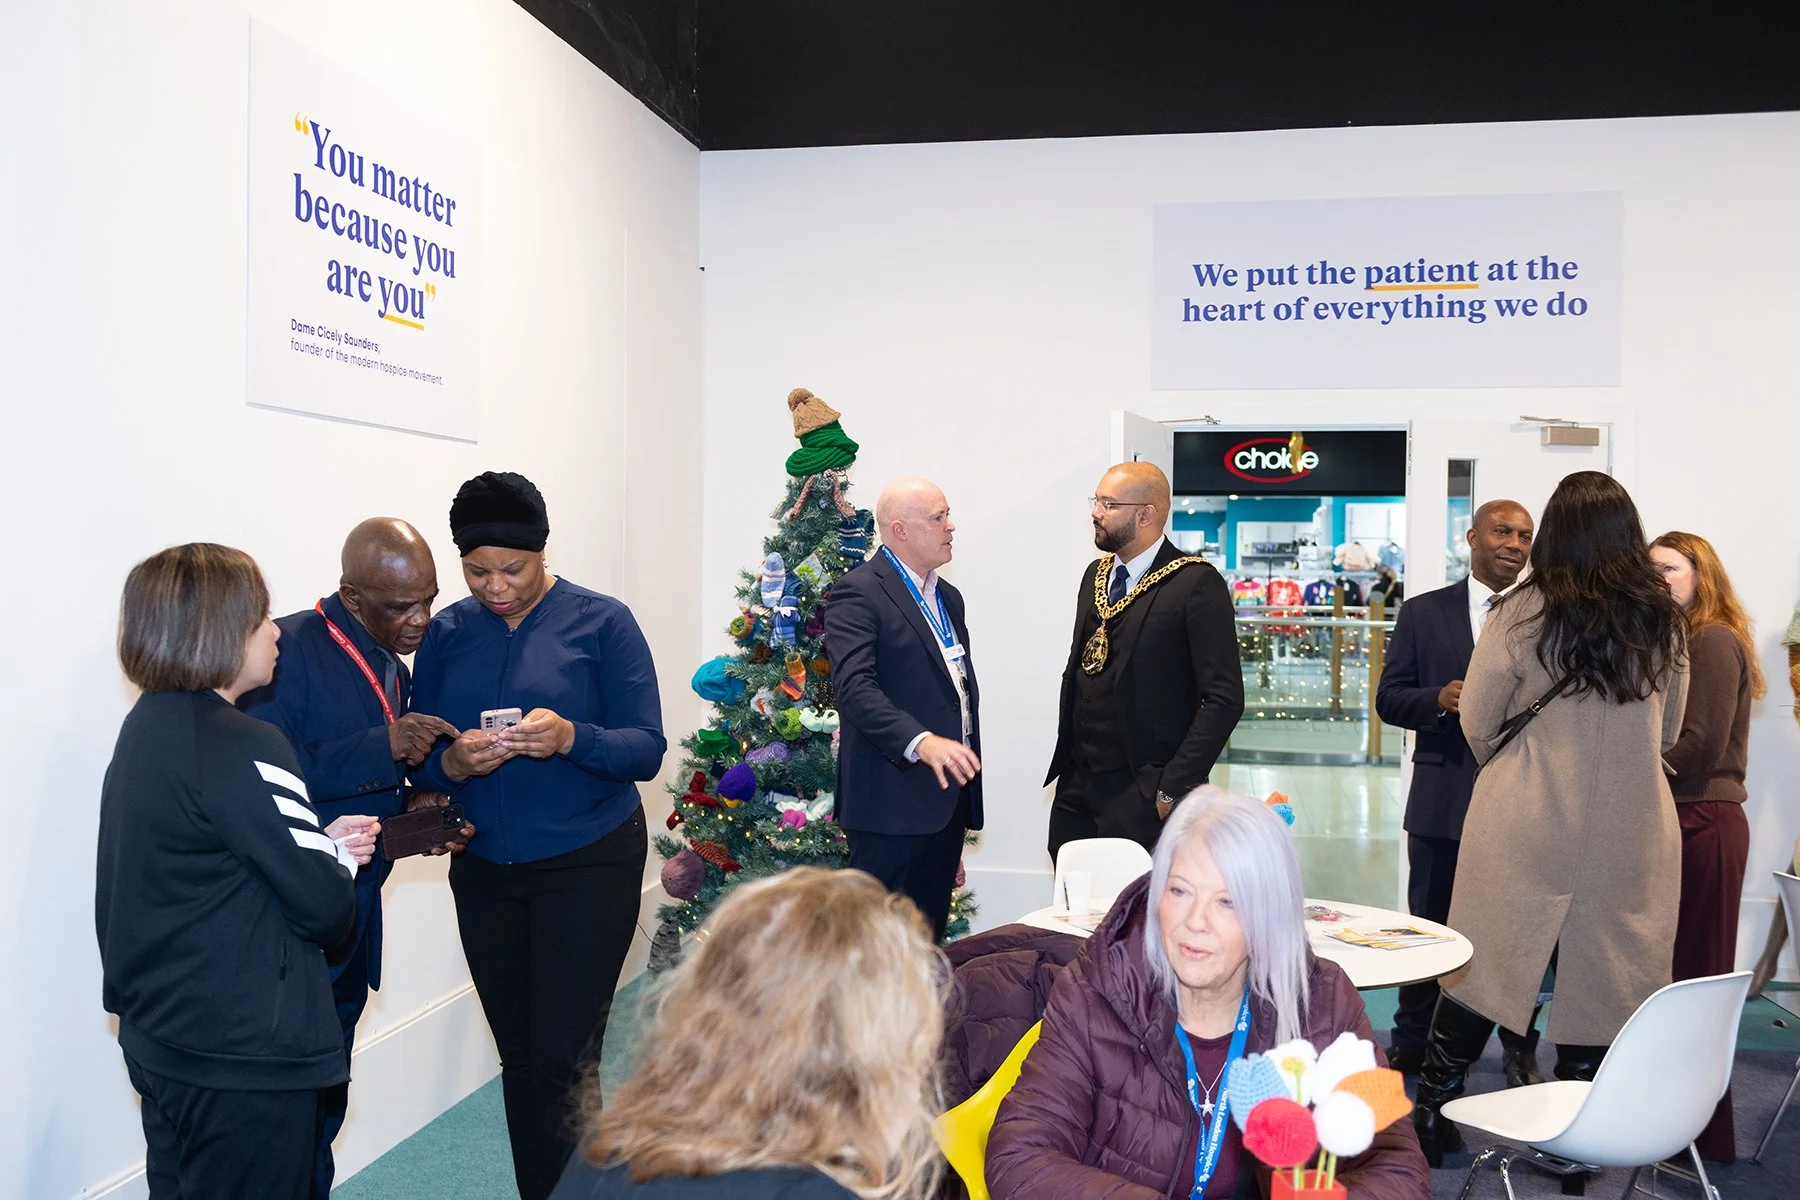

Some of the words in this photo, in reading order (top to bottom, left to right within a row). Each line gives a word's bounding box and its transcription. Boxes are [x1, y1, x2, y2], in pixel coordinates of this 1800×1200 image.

[372, 163, 456, 227] matter
[294, 173, 407, 259] because
[413, 235, 456, 278] you
[327, 259, 372, 303] are
[1192, 263, 1238, 288] We
[1246, 262, 1299, 291] put
[1305, 259, 1356, 285] the
[1364, 257, 1479, 290] patient
[1487, 257, 1518, 281] at
[1525, 254, 1579, 281] the
[1182, 298, 1266, 322] heart
[1272, 295, 1310, 321] of
[1312, 293, 1486, 325] everything
[1494, 296, 1538, 318] we
[1546, 291, 1589, 316] do
[291, 318, 315, 336] Dame
[317, 325, 343, 346] Cicely
[344, 332, 381, 354] Saunders,
[290, 337, 323, 357] founder
[325, 347, 334, 360] of
[336, 349, 349, 366] the
[350, 355, 379, 370] modern
[380, 360, 408, 377] hospice
[1218, 1087, 1230, 1111] North
[1211, 1111, 1225, 1143] London
[1203, 1141, 1218, 1174] Hospice
